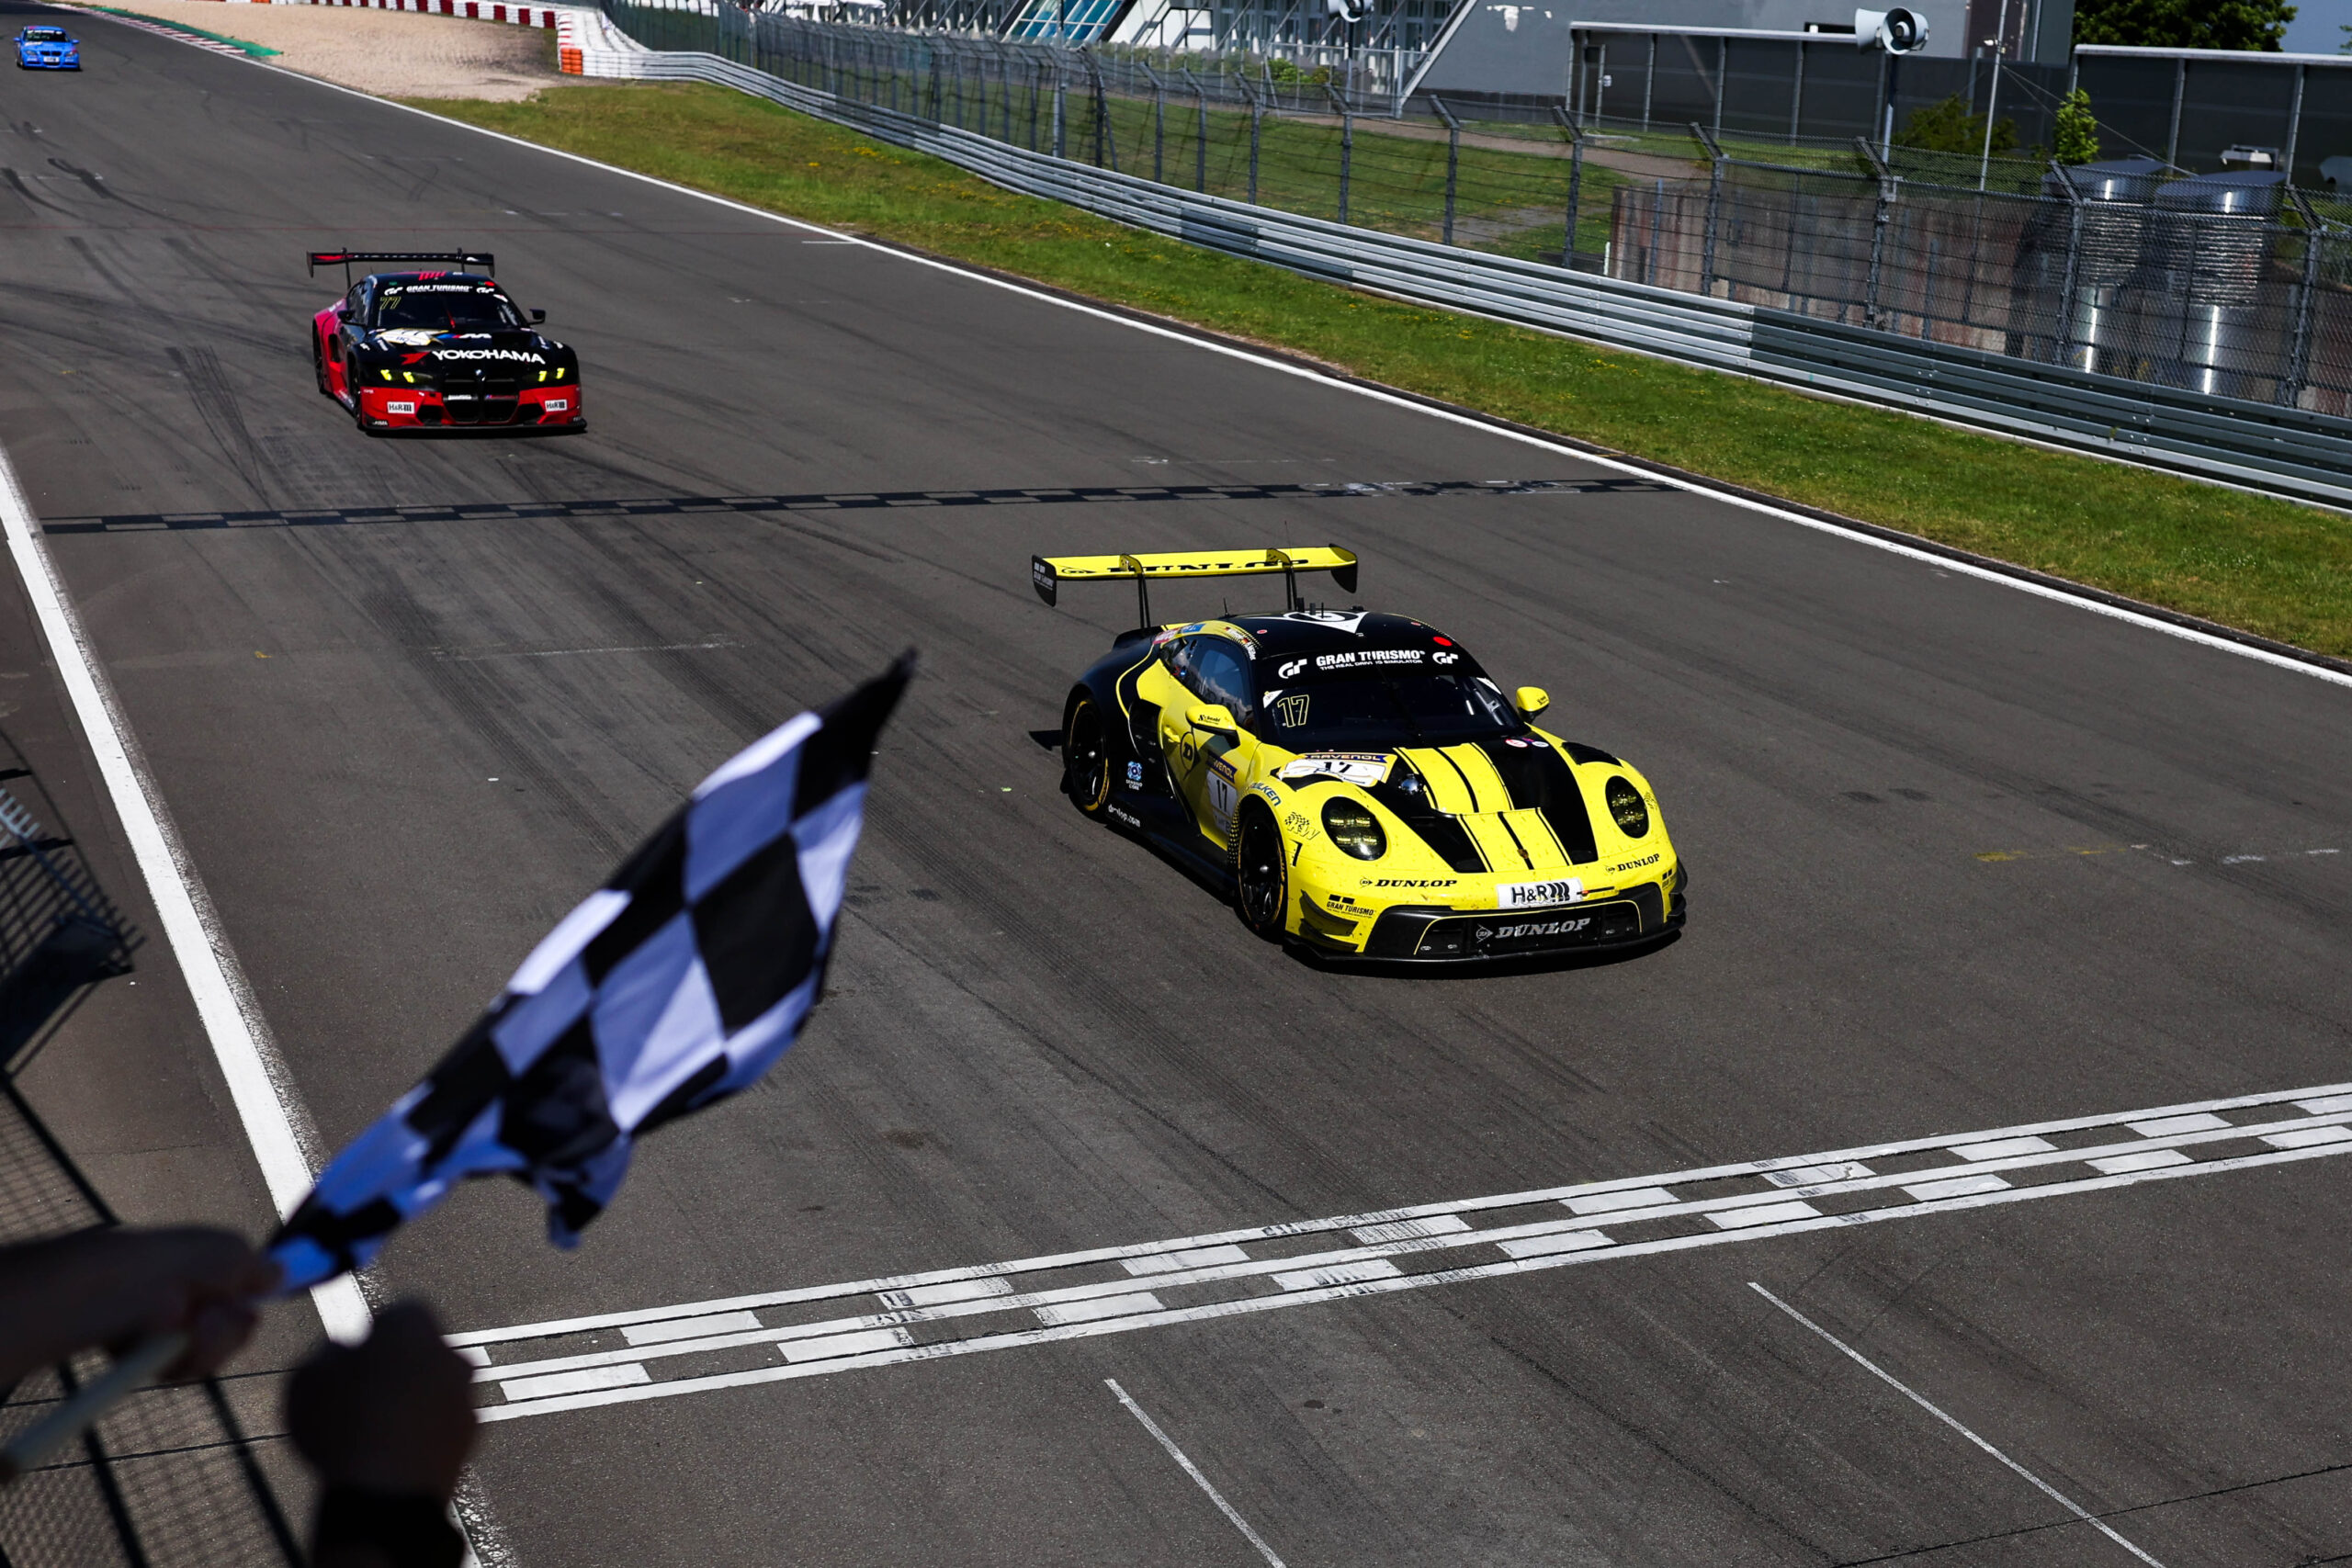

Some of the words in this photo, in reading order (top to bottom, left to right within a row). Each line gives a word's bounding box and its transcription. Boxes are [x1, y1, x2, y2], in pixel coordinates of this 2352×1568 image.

[432, 284, 470, 292] TURISMO
[380, 296, 401, 310] 77
[433, 349, 546, 365] YOKOHAMA
[1317, 653, 1355, 668] GRAN
[1358, 650, 1420, 661] TURISMO
[1277, 694, 1309, 728] 17
[1216, 780, 1228, 812] 17
[1617, 852, 1660, 872] DUNLOP
[1374, 879, 1457, 887] DUNLOP
[1511, 884, 1549, 903] H&R
[1327, 901, 1344, 911] GRAN
[1345, 905, 1374, 916] TURISMO
[1495, 918, 1590, 938] DUNLOP
